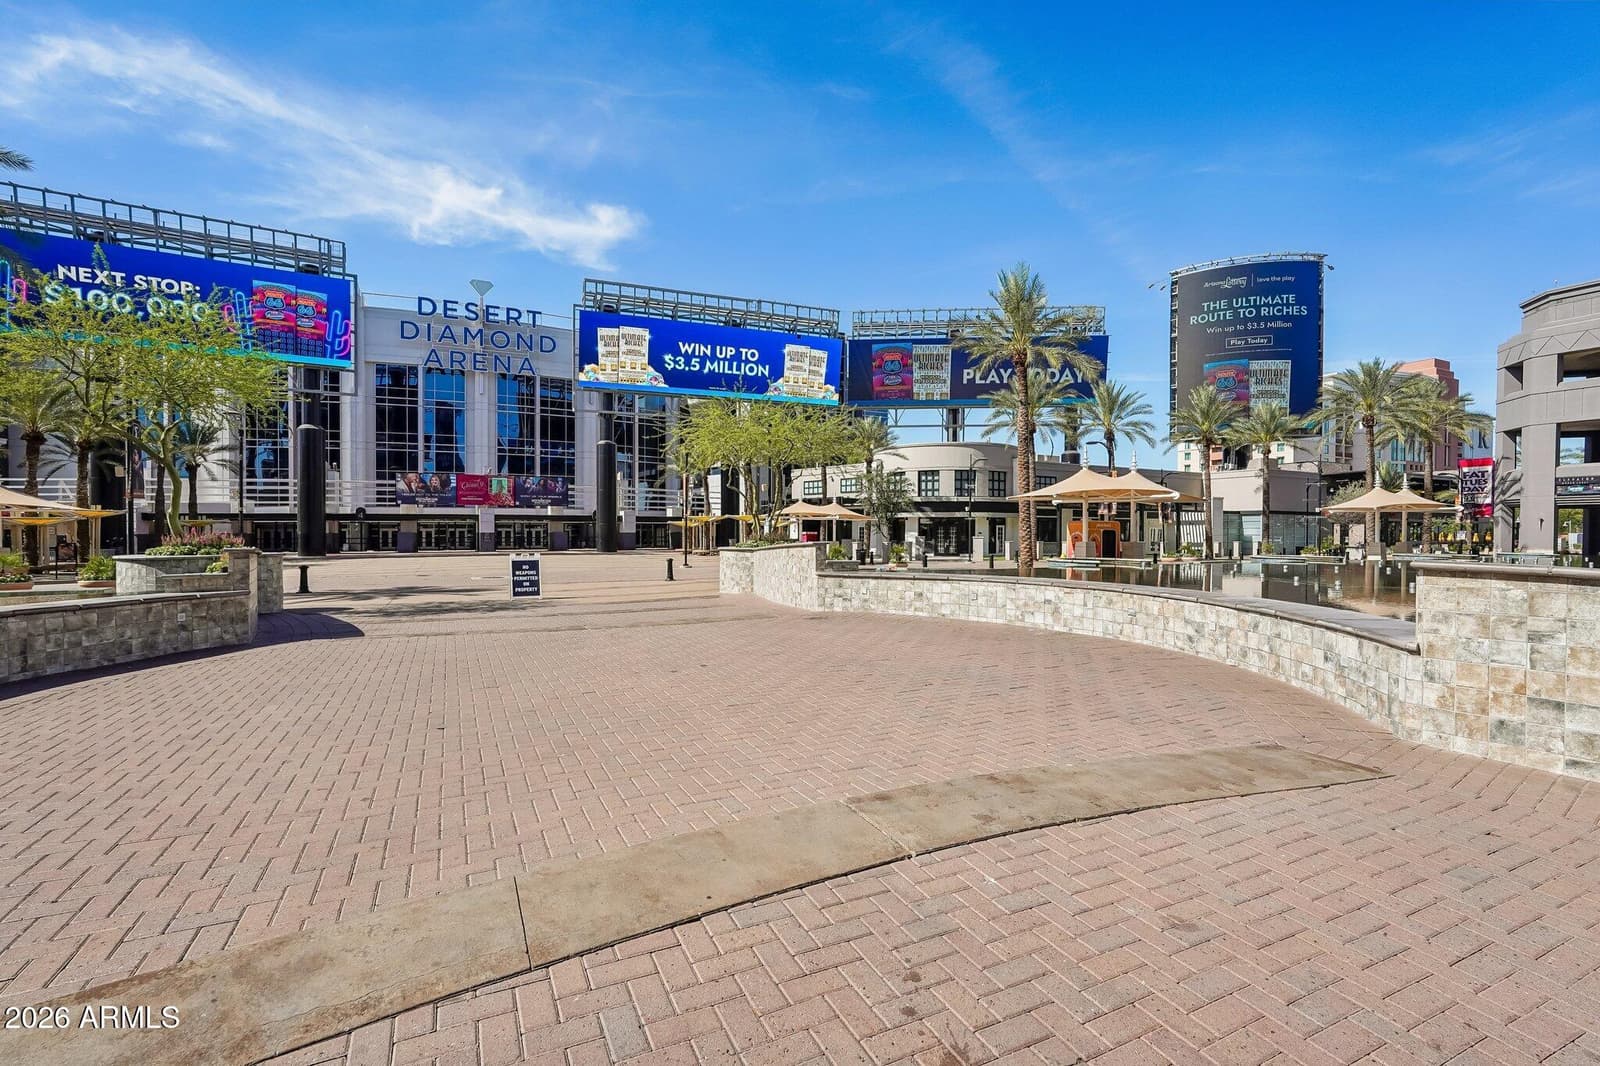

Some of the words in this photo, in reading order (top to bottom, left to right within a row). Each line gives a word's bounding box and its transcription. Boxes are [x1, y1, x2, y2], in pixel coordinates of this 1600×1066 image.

[57, 264, 126, 287] NEXT
[134, 274, 201, 298] STOP:
[417, 296, 542, 329] DESERT
[1202, 299, 1228, 311] THE
[1233, 294, 1296, 308] ULTIMATE
[1190, 309, 1233, 325] ROUTE
[1238, 307, 1256, 318] TO
[1261, 305, 1308, 317] RICHES
[400, 320, 557, 353] DIAMOND
[1206, 326, 1222, 334] Win
[1224, 326, 1235, 334] up
[1247, 321, 1265, 330] $3.5
[1267, 320, 1293, 329] Million
[1230, 337, 1245, 346] Play
[1248, 336, 1268, 345] Today
[678, 341, 711, 357] WIN
[716, 346, 736, 361] UP
[739, 348, 759, 362] TO
[423, 349, 536, 375] ARENA
[664, 353, 700, 372] $3.5
[703, 359, 769, 378] MILLION
[962, 368, 1013, 385] PLAY
[1461, 478, 1488, 486] TUES
[1463, 470, 1488, 479] FAT
